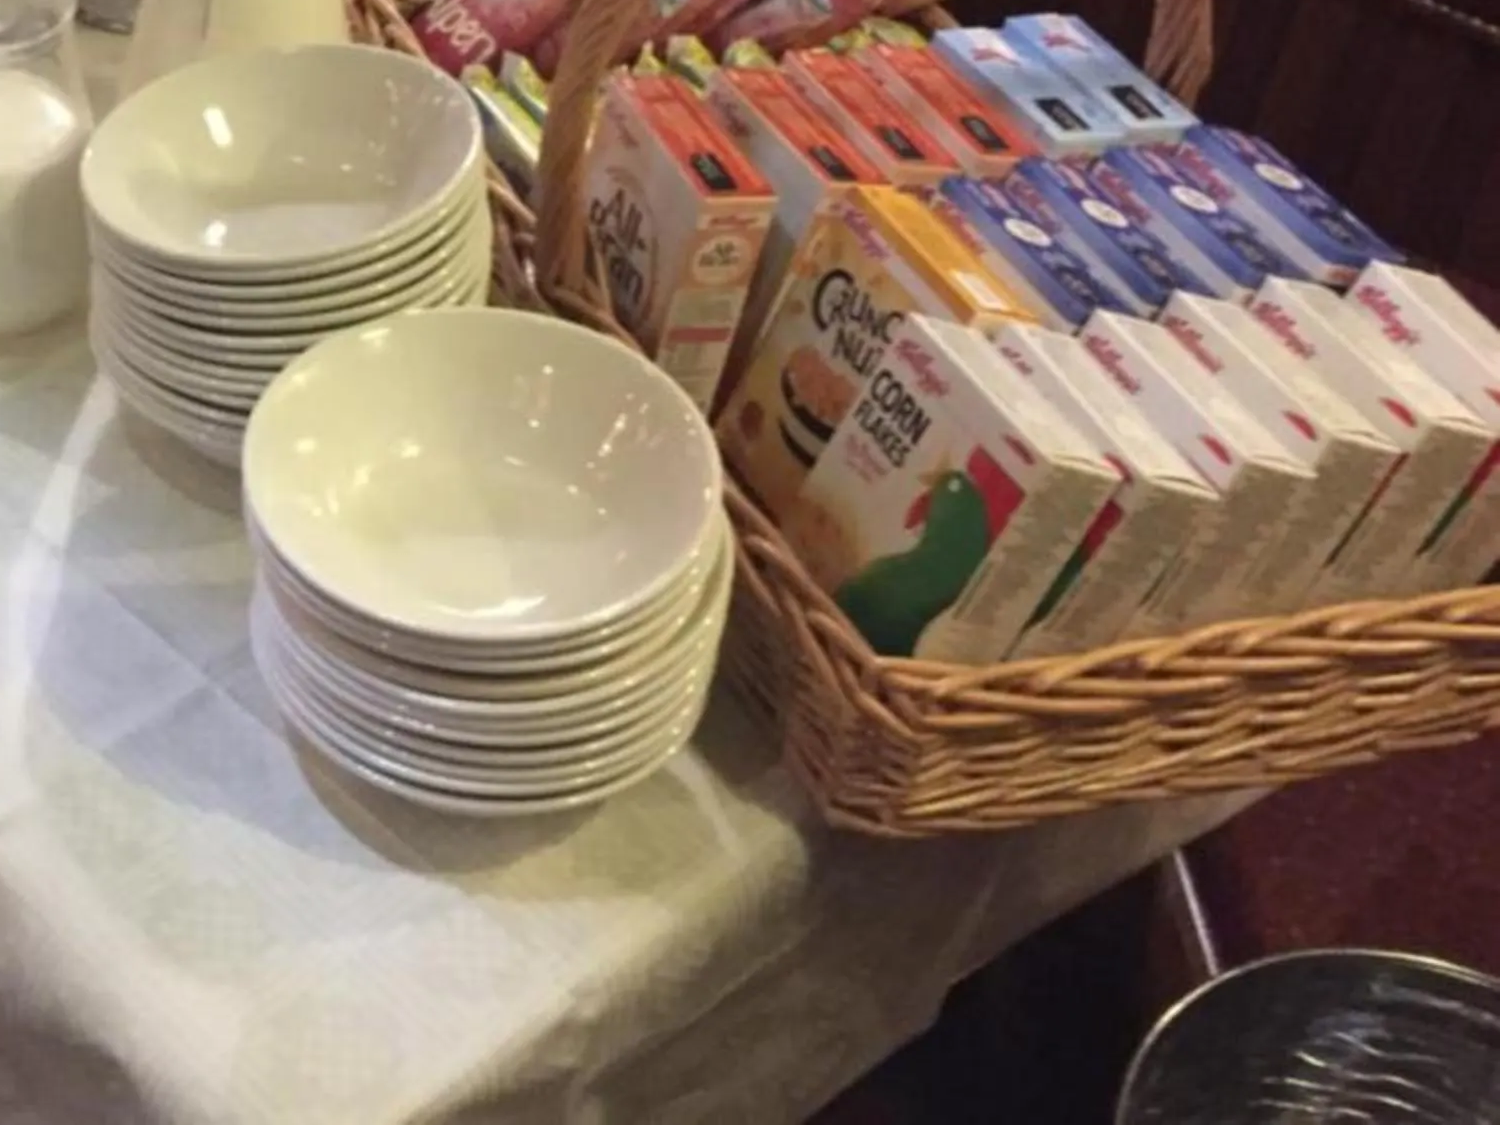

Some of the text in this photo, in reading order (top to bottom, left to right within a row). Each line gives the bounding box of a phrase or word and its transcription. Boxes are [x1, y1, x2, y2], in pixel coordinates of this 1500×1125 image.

[812, 269, 906, 344] CRUNC
[852, 399, 912, 468] FLAKES
[871, 368, 933, 445] CORN
